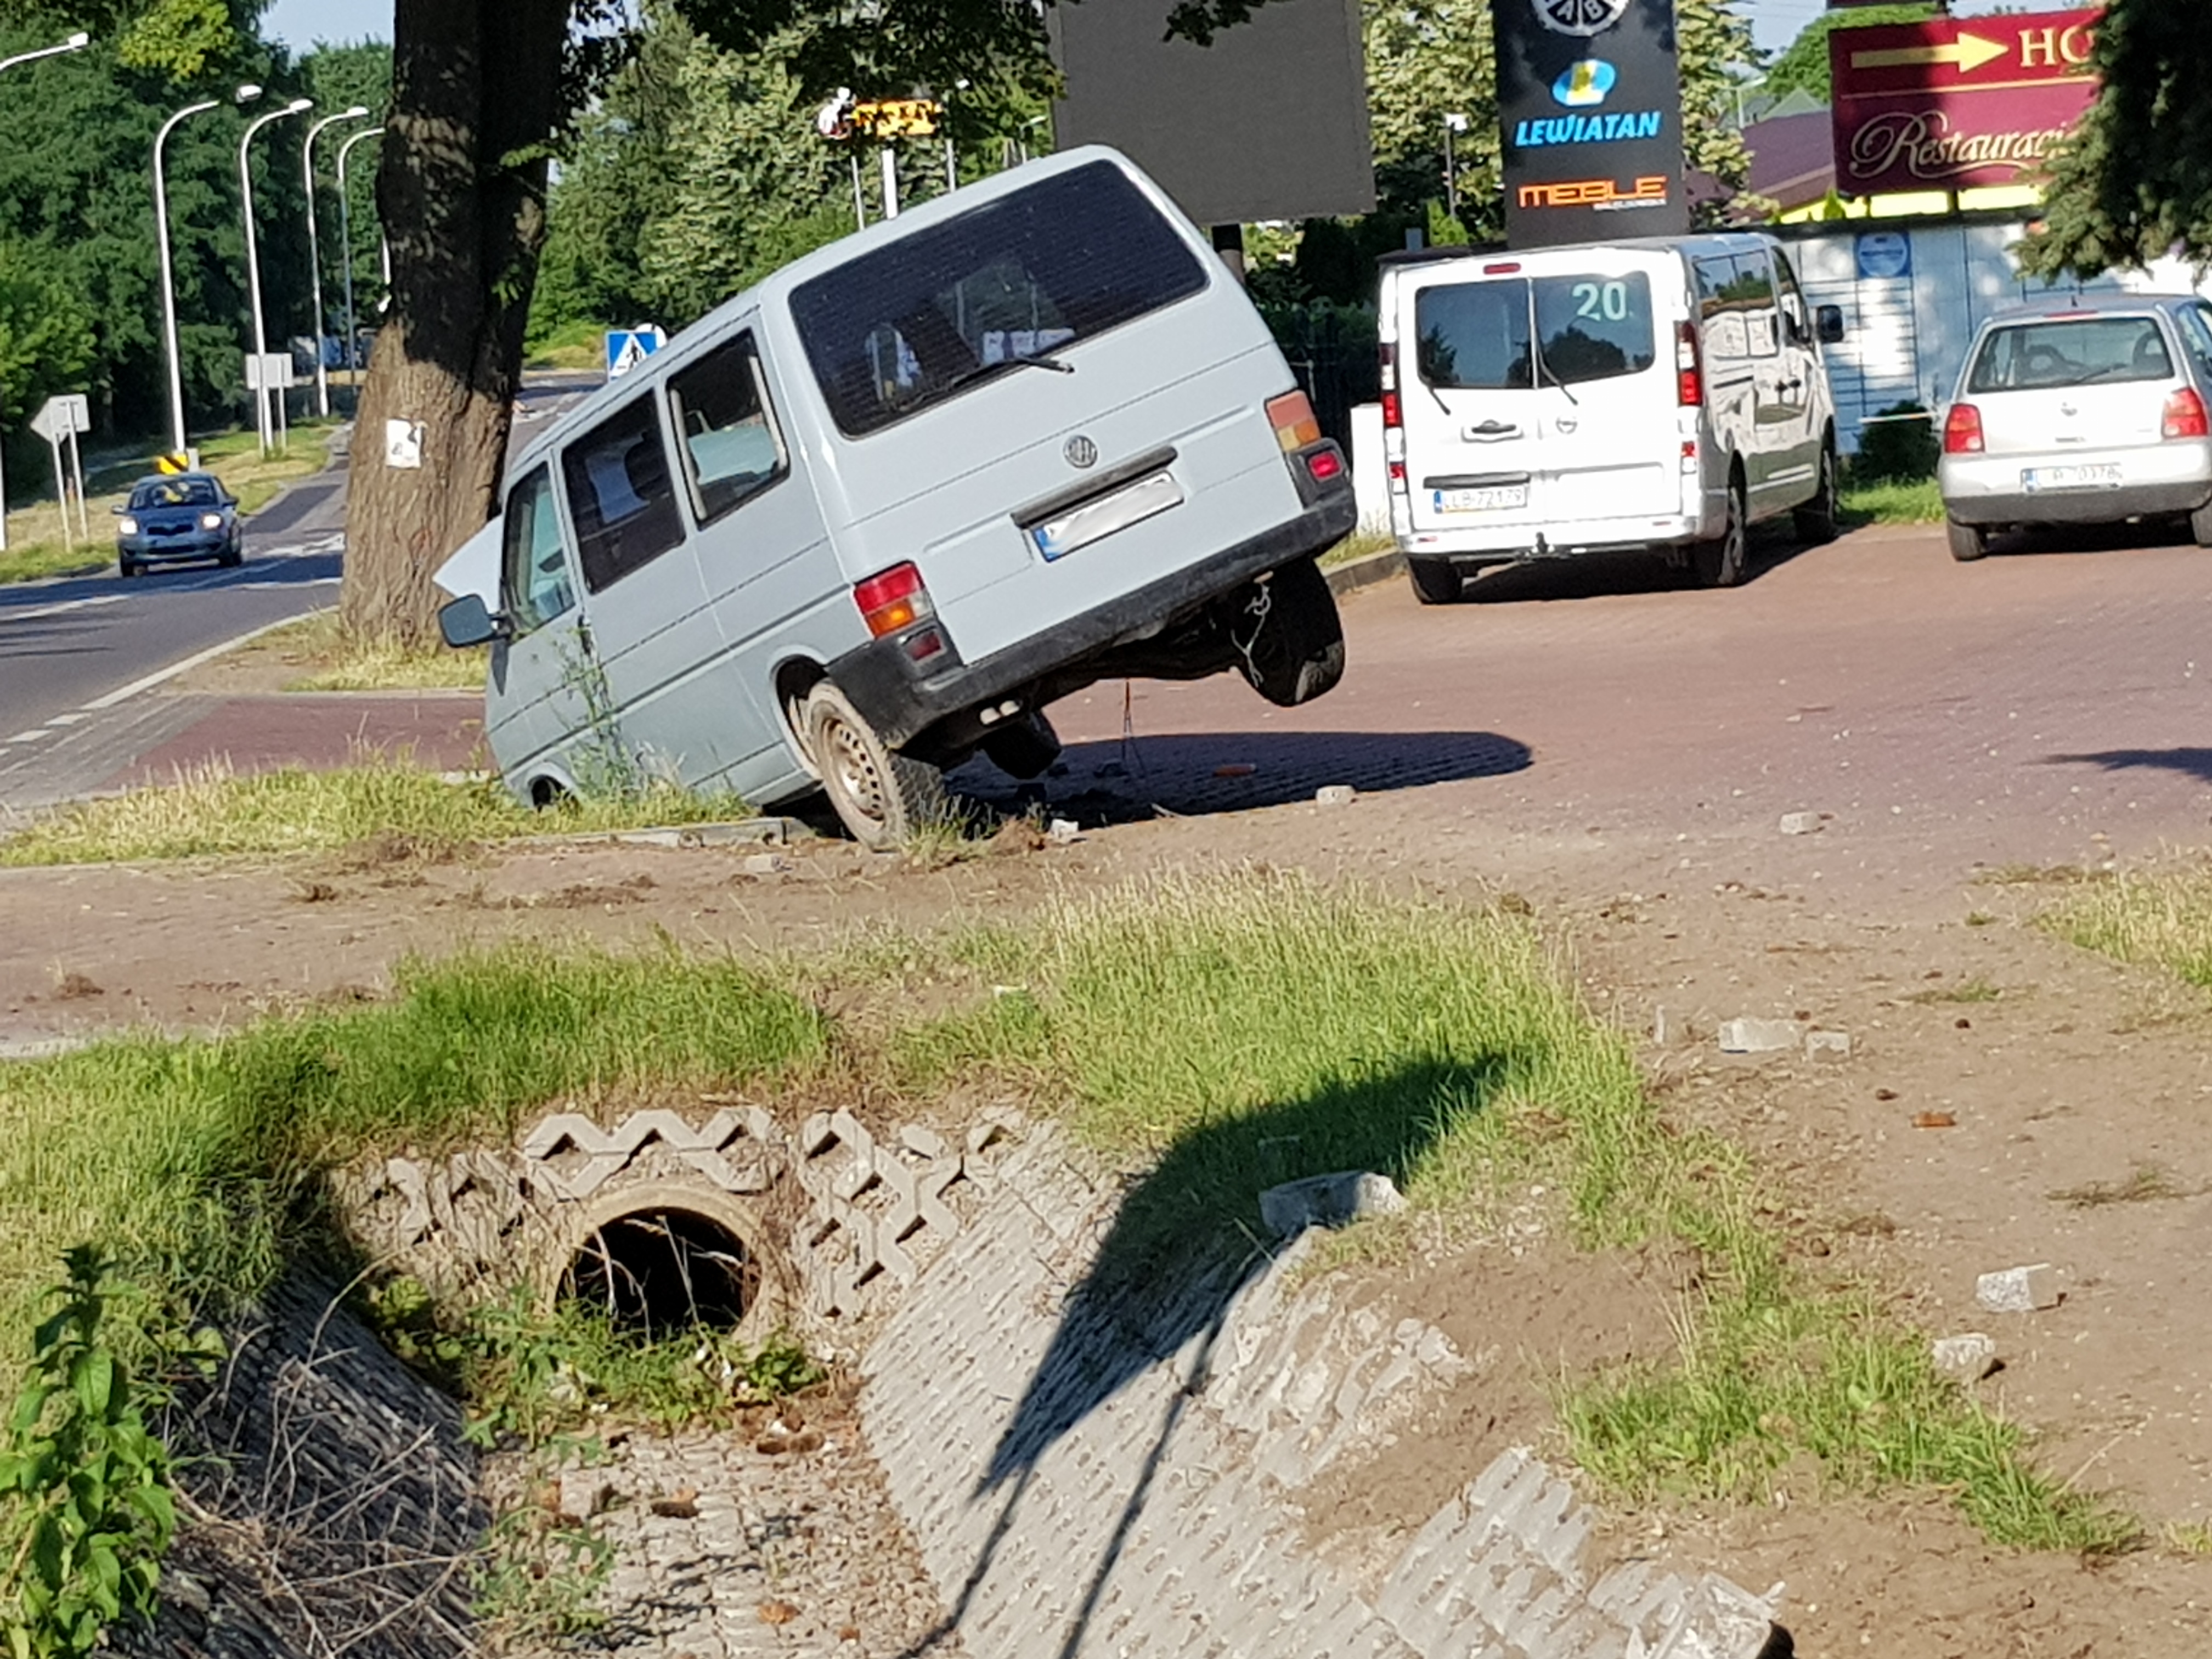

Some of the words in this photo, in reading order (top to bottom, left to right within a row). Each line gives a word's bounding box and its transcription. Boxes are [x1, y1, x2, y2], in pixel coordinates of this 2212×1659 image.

[1515, 111, 1661, 147] LEWIATAN
[1517, 175, 1668, 208] MEBLE
[1572, 281, 1627, 321] 20
